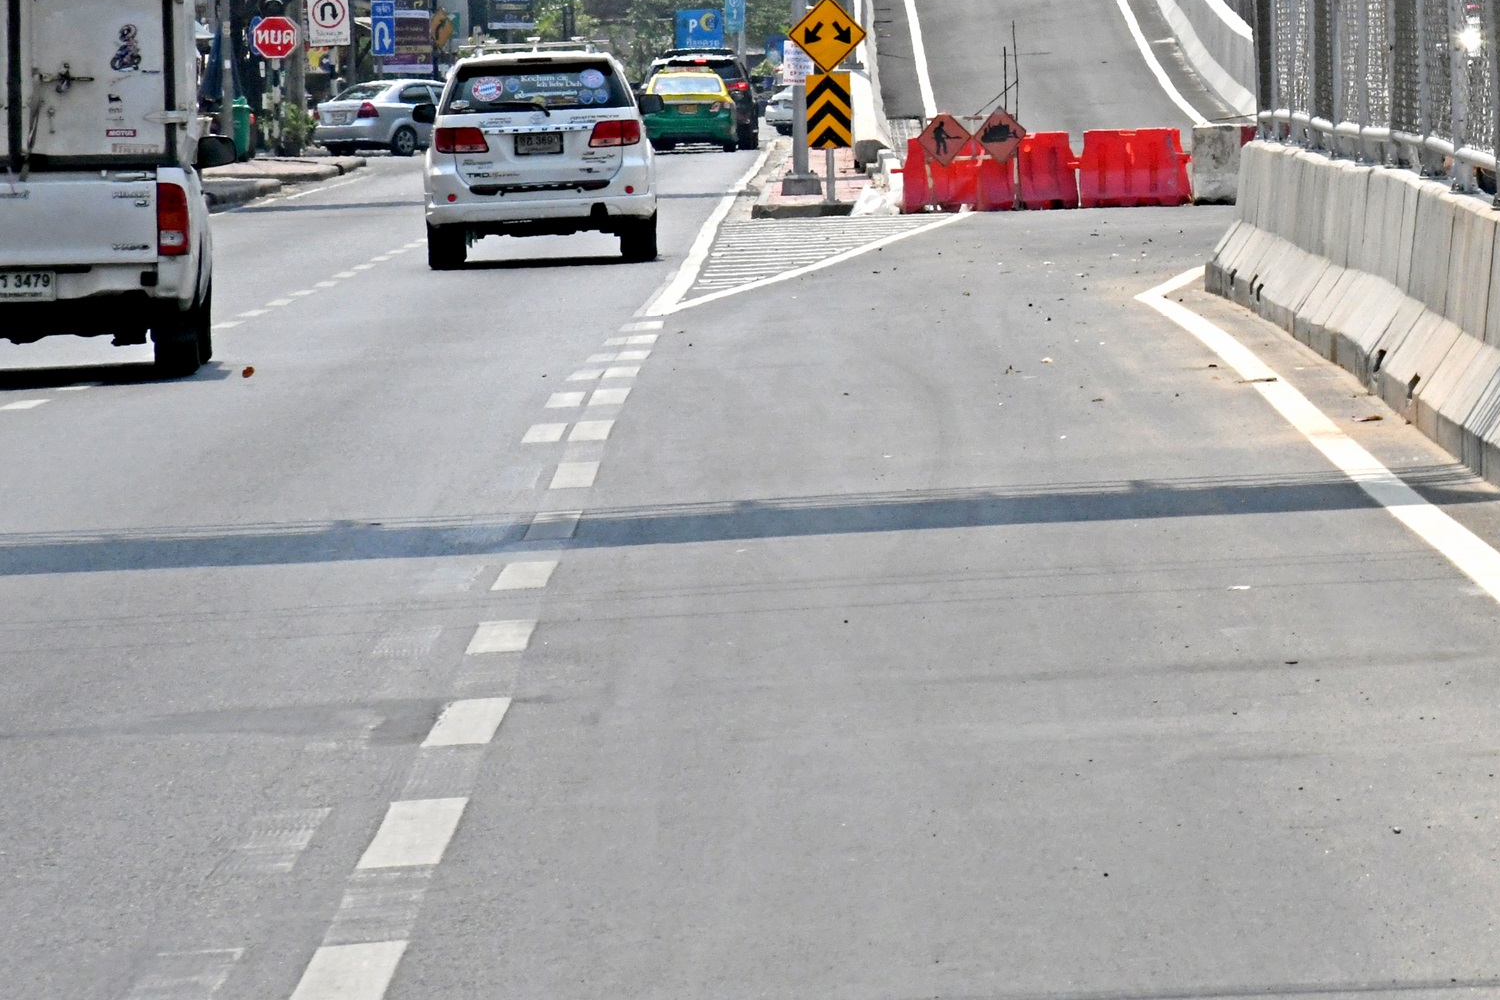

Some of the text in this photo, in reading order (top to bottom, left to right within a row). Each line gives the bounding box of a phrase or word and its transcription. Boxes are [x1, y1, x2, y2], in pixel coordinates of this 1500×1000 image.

[688, 18, 698, 33] P
[256, 29, 295, 51] หยุด
[521, 74, 555, 82] Kocham
[14, 273, 51, 288] 3479
